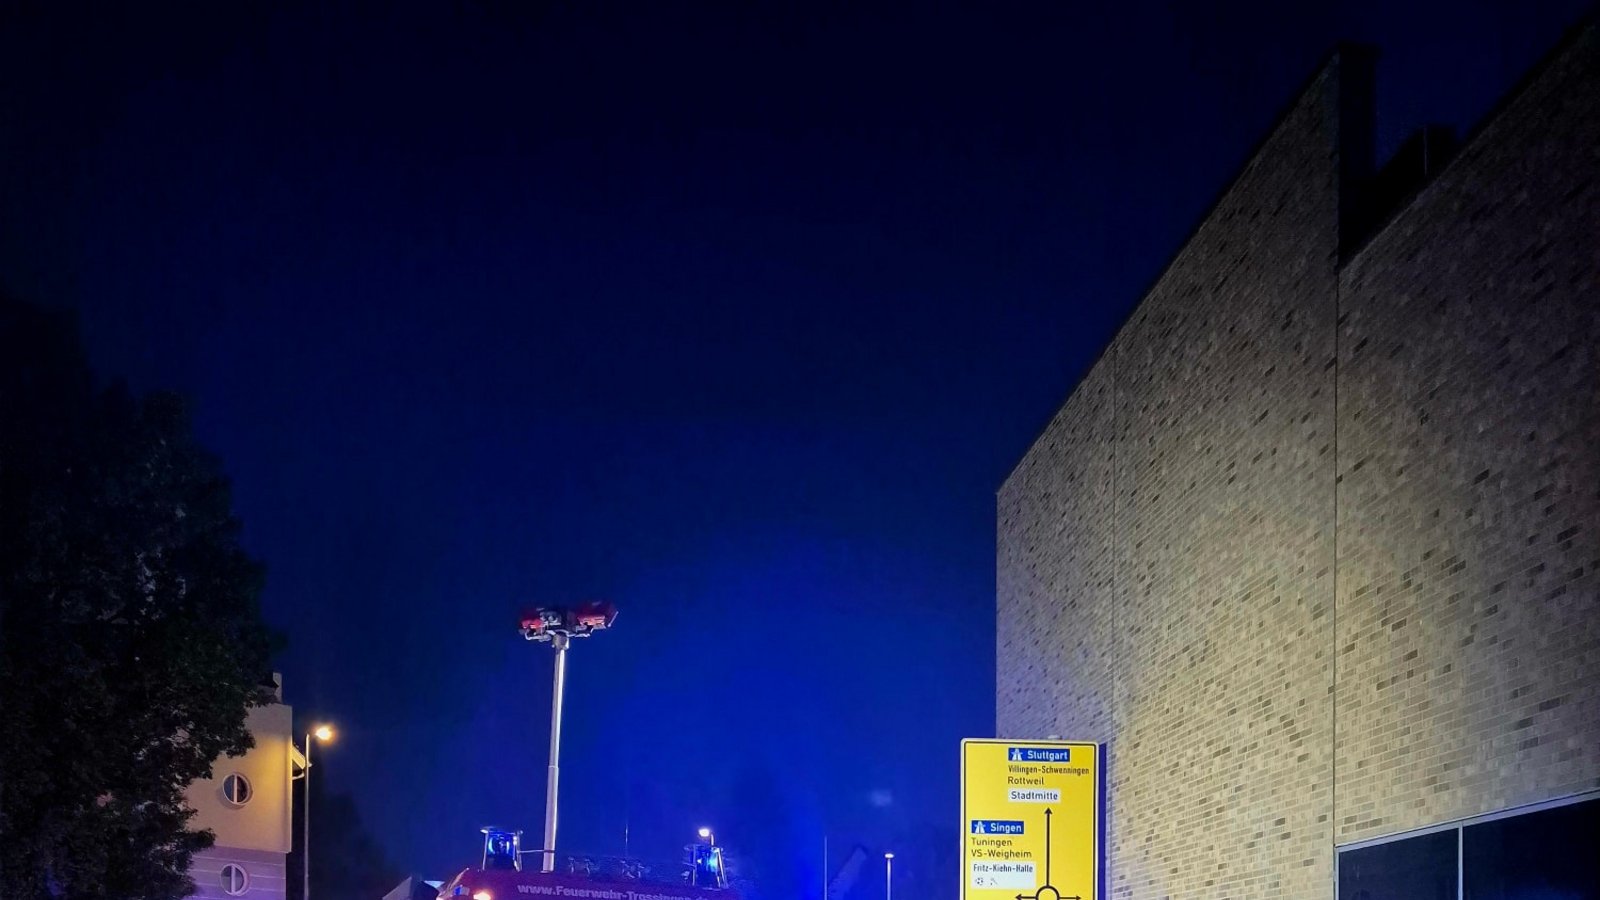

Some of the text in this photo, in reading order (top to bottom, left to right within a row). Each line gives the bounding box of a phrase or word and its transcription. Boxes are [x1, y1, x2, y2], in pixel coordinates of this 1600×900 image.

[1027, 750, 1068, 761] Stuttgart
[1008, 765, 1089, 776] Villingen-Schwenningen
[1007, 777, 1044, 786] Rottweil
[1011, 791, 1058, 800] Stadtmitte
[990, 823, 1022, 834] Singen
[971, 837, 1012, 848] Tuningen
[971, 849, 1032, 860] VS-Weigheim
[973, 863, 1034, 873] Fritz-Kiehn-Halle
